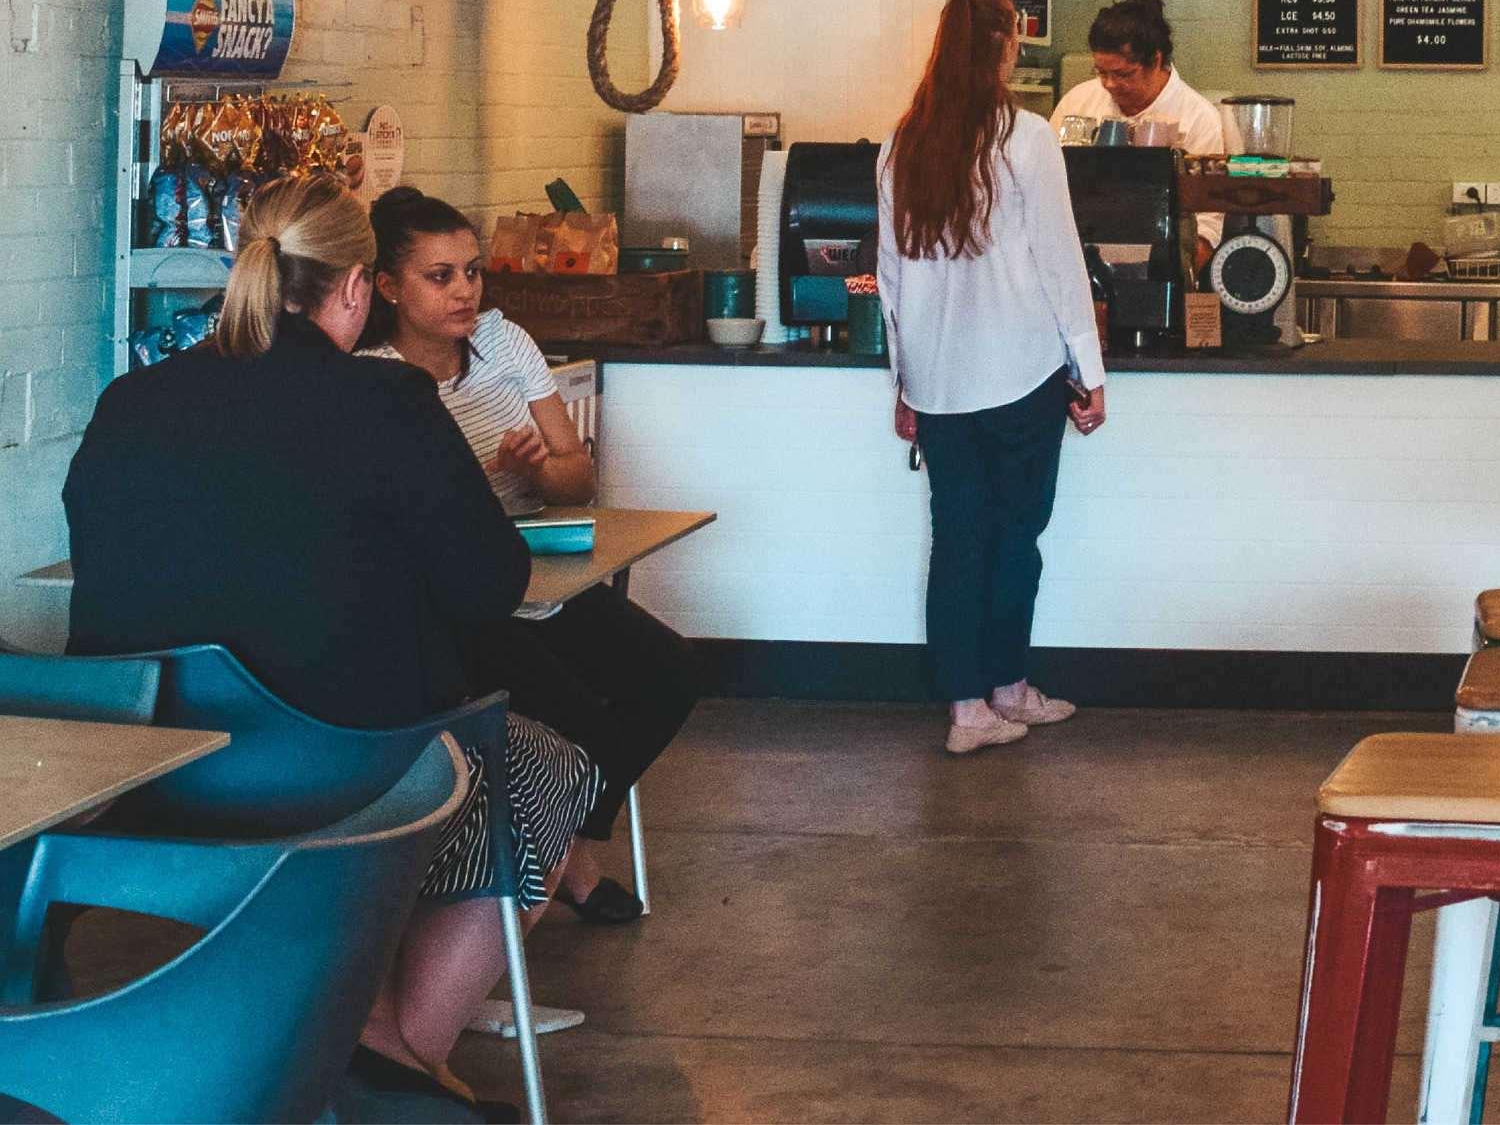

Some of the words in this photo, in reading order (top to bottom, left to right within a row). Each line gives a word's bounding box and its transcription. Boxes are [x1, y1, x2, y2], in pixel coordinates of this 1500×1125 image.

[1421, 6, 1434, 14] TEA
[1312, 11, 1336, 21] $4.50
[1276, 27, 1298, 35] EXTRA
[212, 24, 273, 59] SNACK?
[1417, 35, 1447, 45] $4.00
